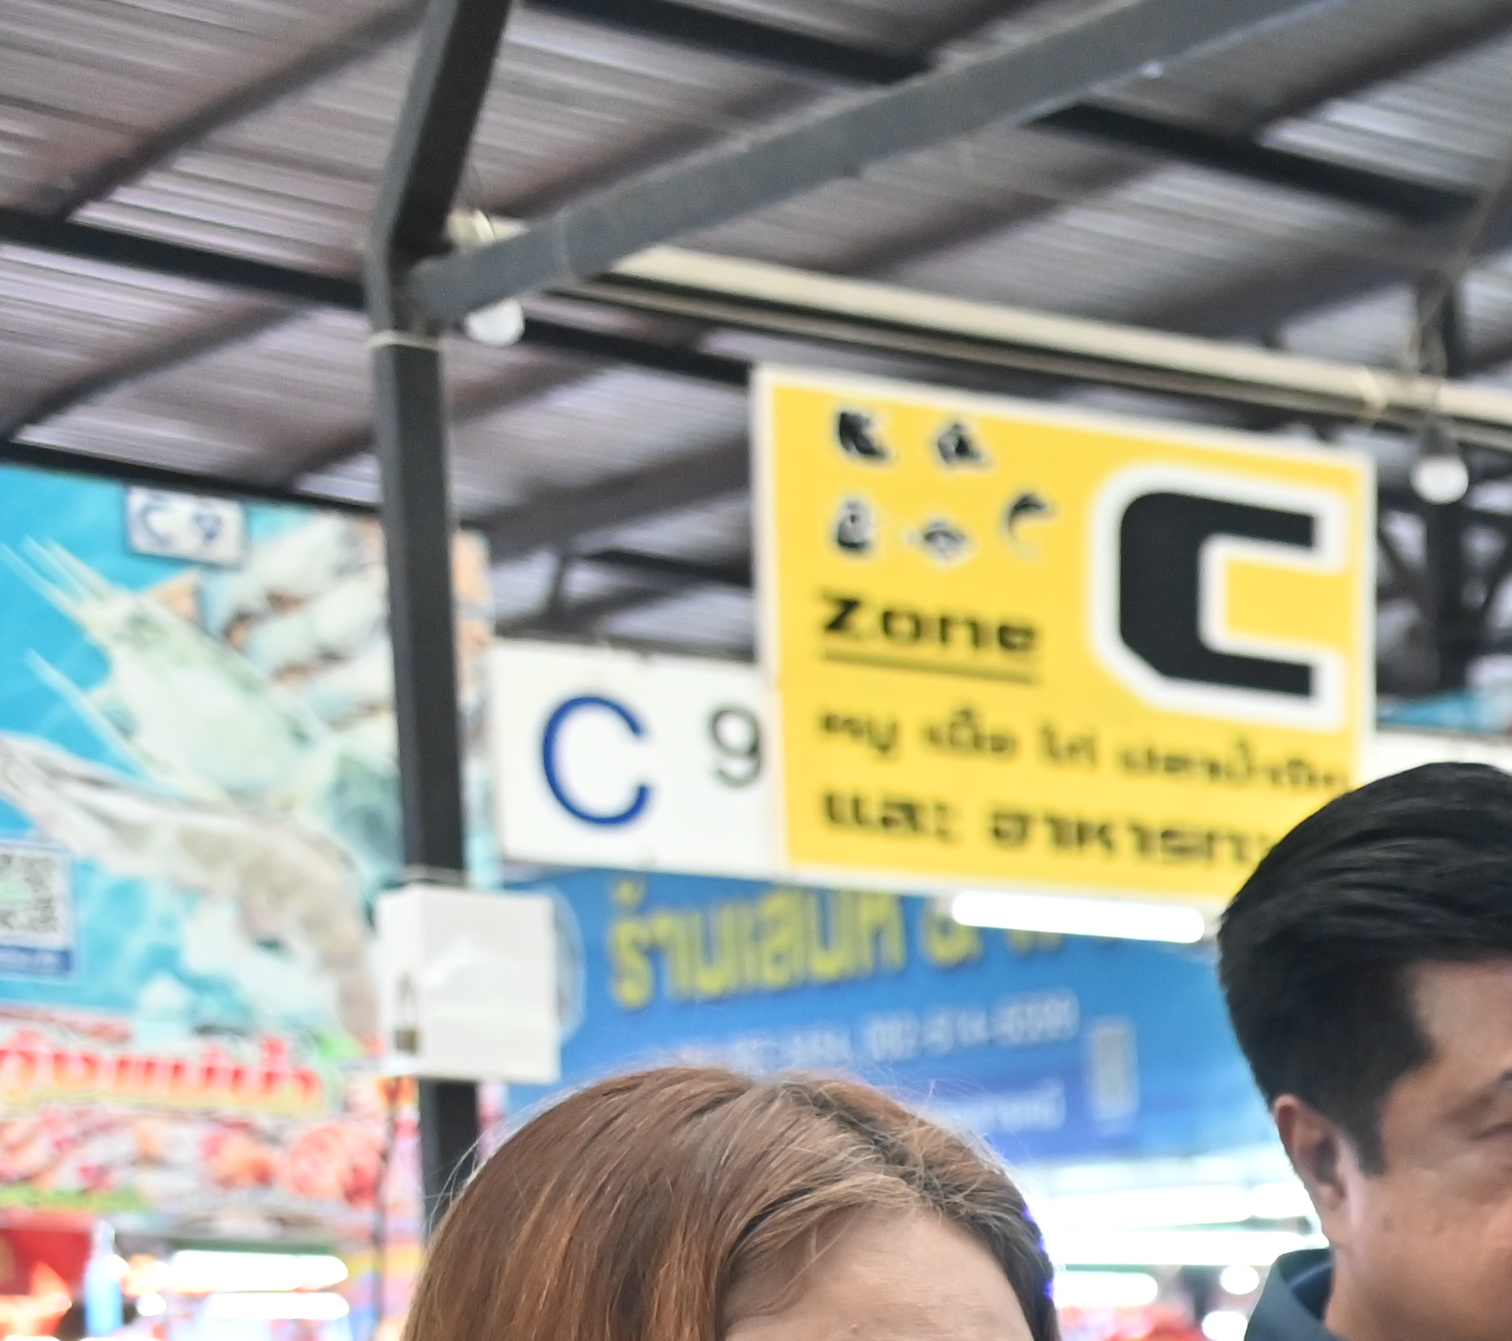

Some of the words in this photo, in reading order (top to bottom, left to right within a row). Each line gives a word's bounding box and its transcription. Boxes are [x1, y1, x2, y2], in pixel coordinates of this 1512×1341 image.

[822, 594, 1038, 657] Zone
[1120, 492, 1313, 697] C
[541, 694, 650, 827] C
[707, 706, 762, 787] 9
